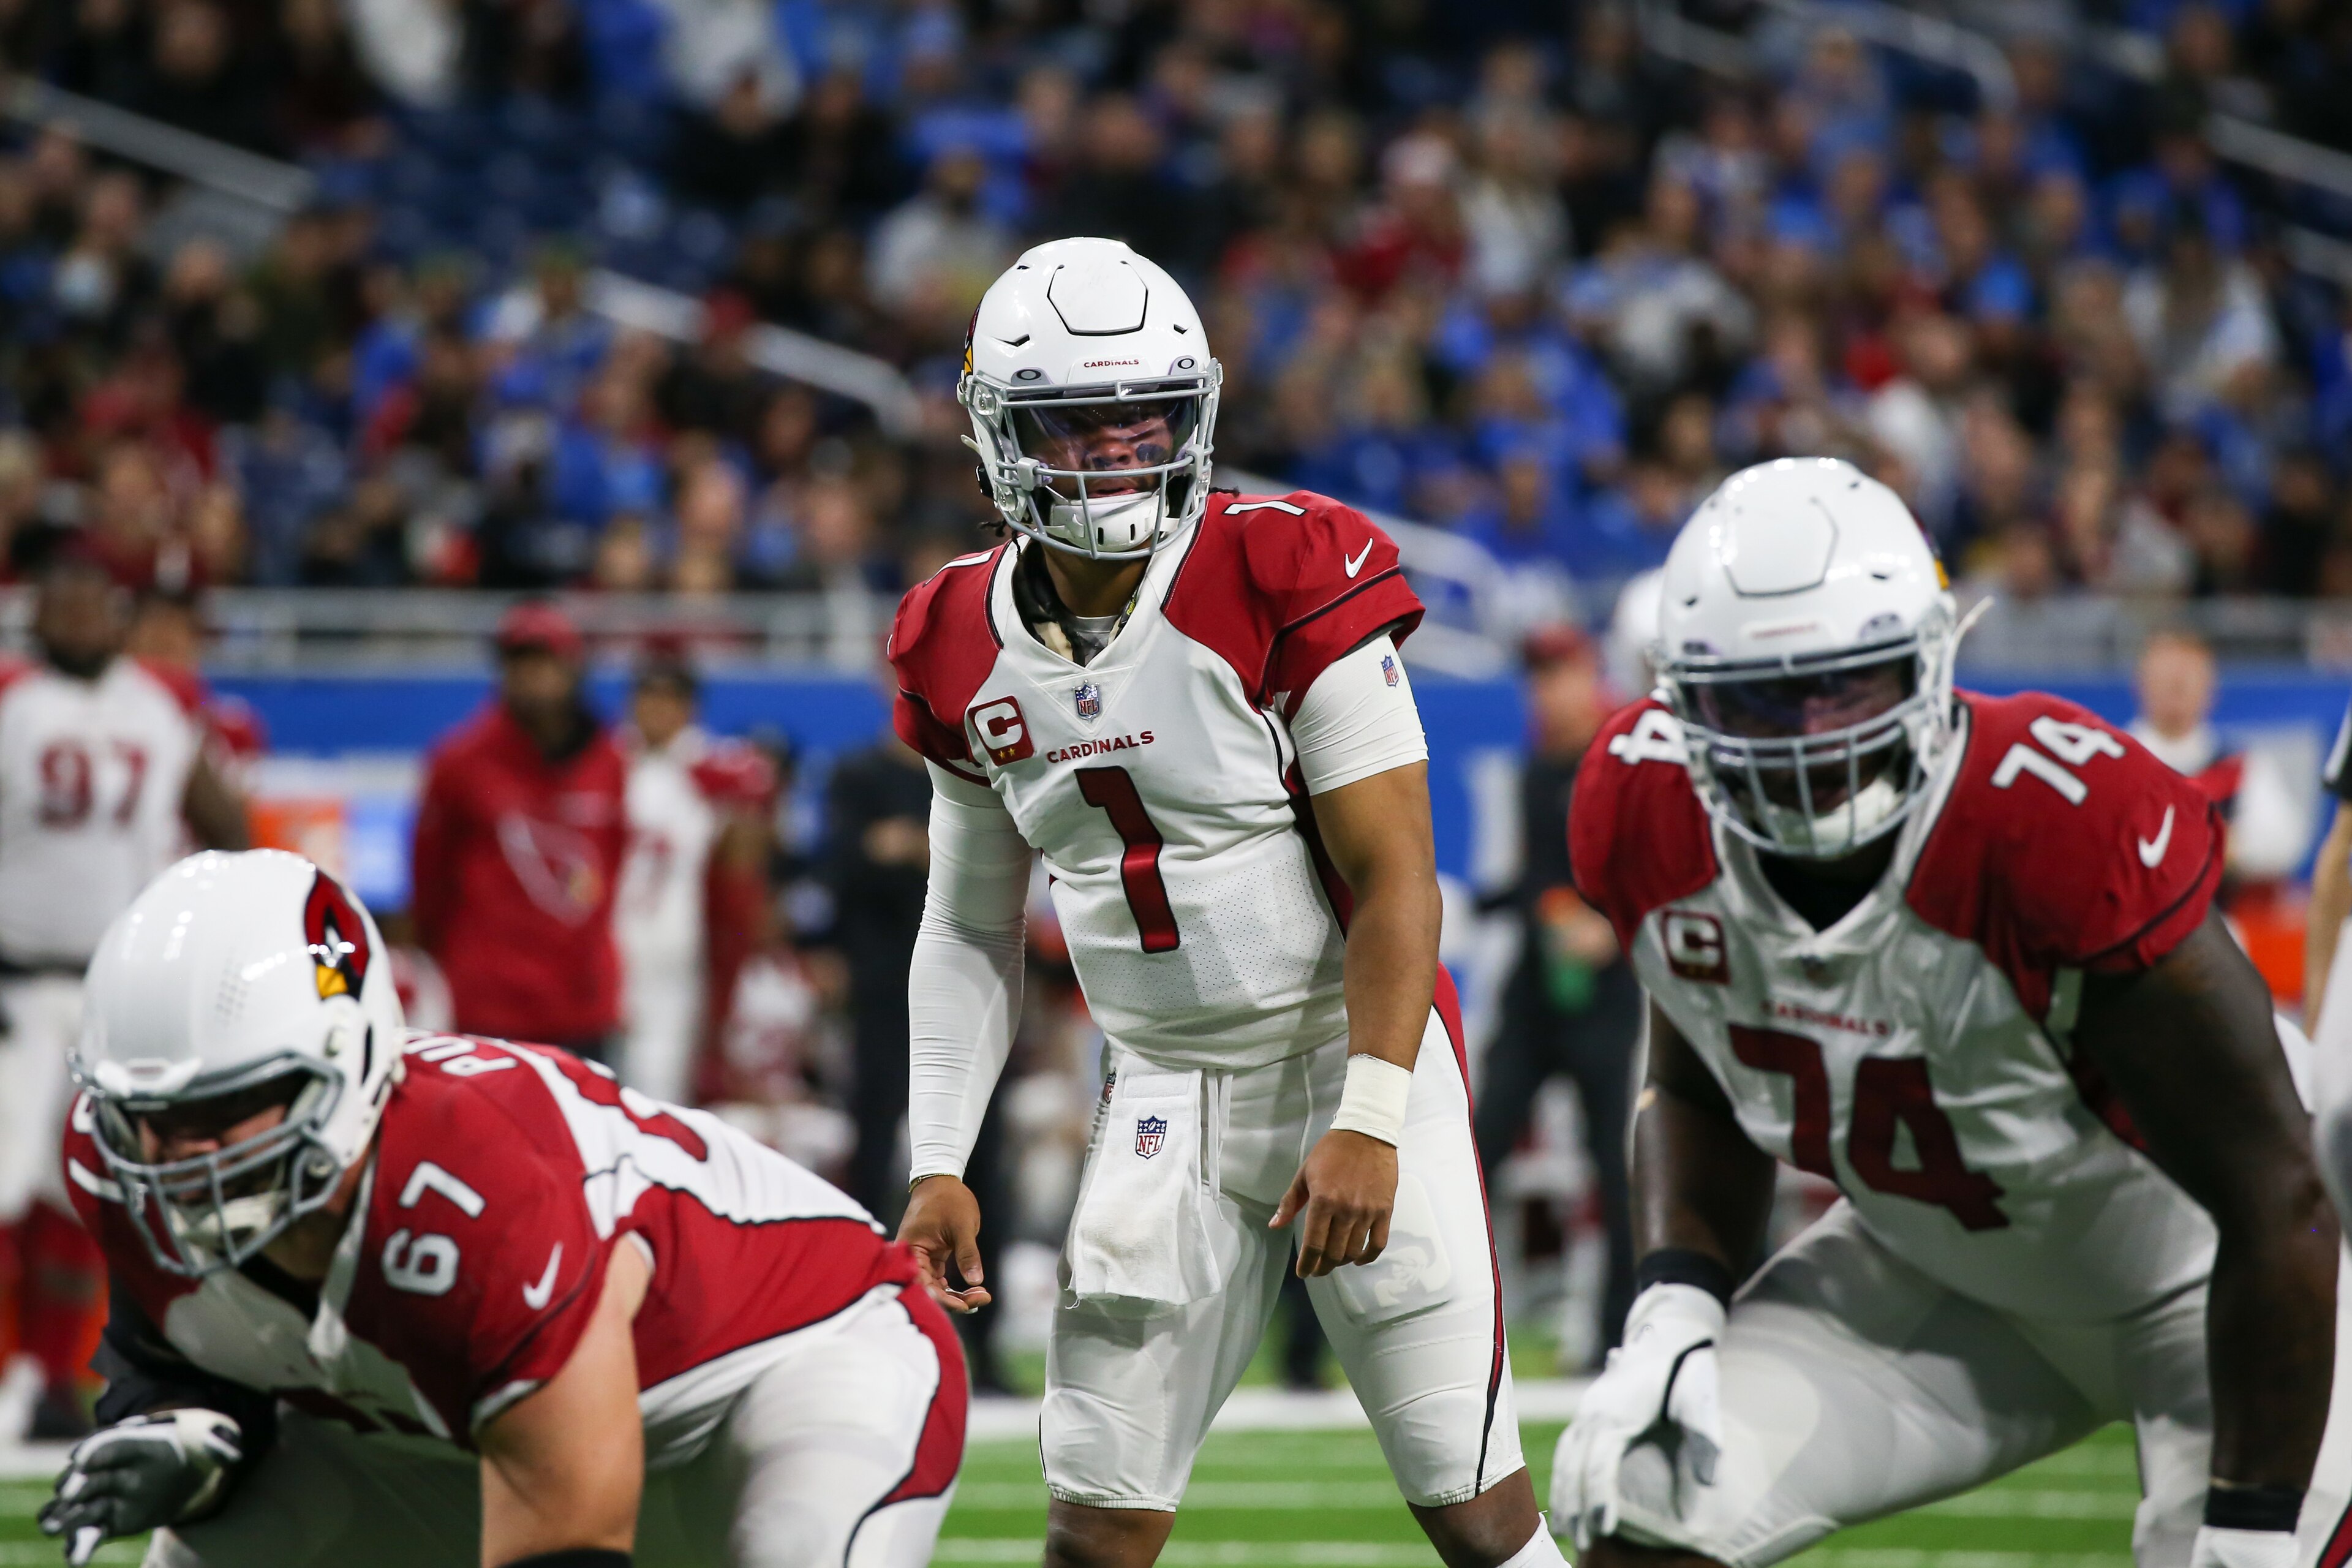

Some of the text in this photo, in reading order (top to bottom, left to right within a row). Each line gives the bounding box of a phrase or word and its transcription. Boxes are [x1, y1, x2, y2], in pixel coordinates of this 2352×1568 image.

[1084, 359, 1139, 368] CARDINALS
[1385, 666, 1398, 684] NFL
[974, 702, 1023, 750] C
[1078, 699, 1098, 715] NFL
[1046, 731, 1155, 763] CARDINALS
[1989, 714, 2128, 807] 74
[39, 737, 149, 830] 97
[1074, 765, 1180, 954] 1
[1667, 916, 1720, 967] C
[1137, 1135, 1161, 1155] NFL
[1727, 1022, 2010, 1232] 74
[381, 1160, 486, 1297] 67
